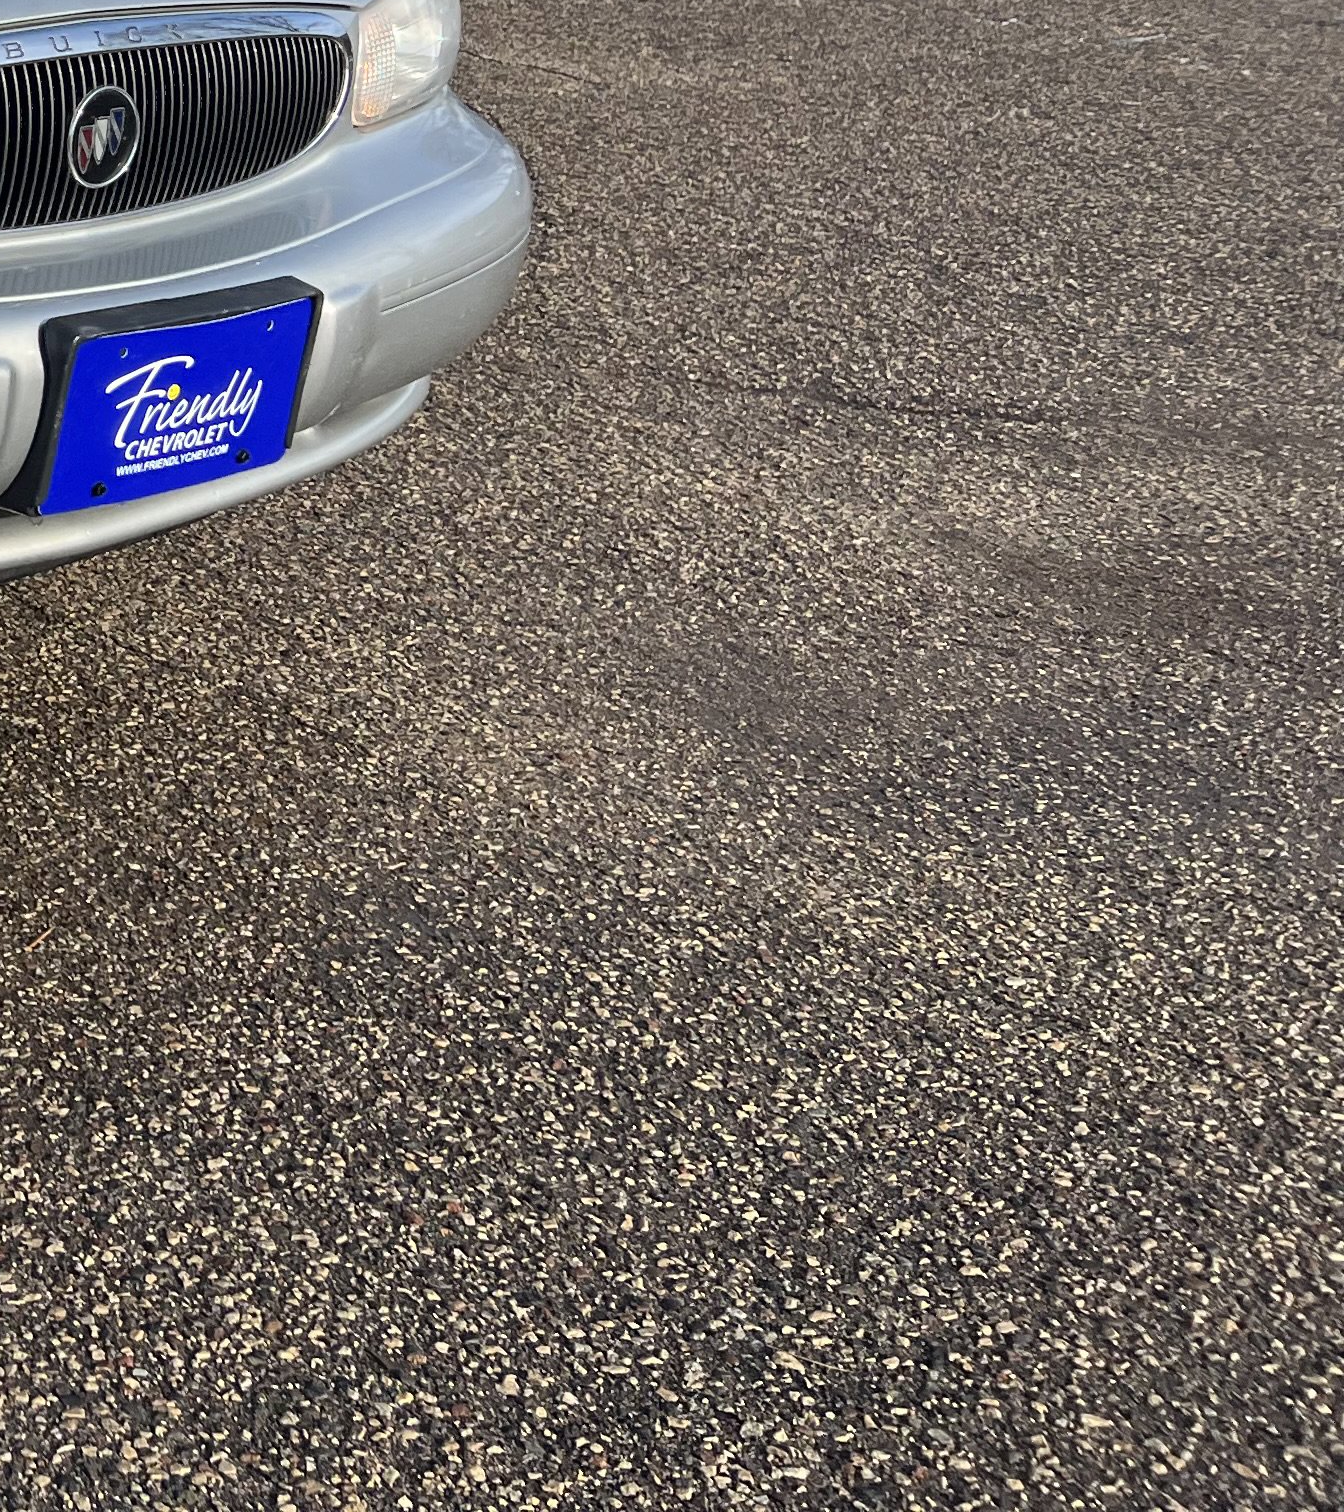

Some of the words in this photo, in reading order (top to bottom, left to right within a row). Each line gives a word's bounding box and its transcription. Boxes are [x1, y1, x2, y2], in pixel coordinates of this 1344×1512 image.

[1, 23, 186, 60] BUICK
[104, 354, 263, 449] Friendly
[115, 443, 229, 477] WWW.FRIENDLYCHEV.COM
[123, 420, 229, 461] CHEVROLET
